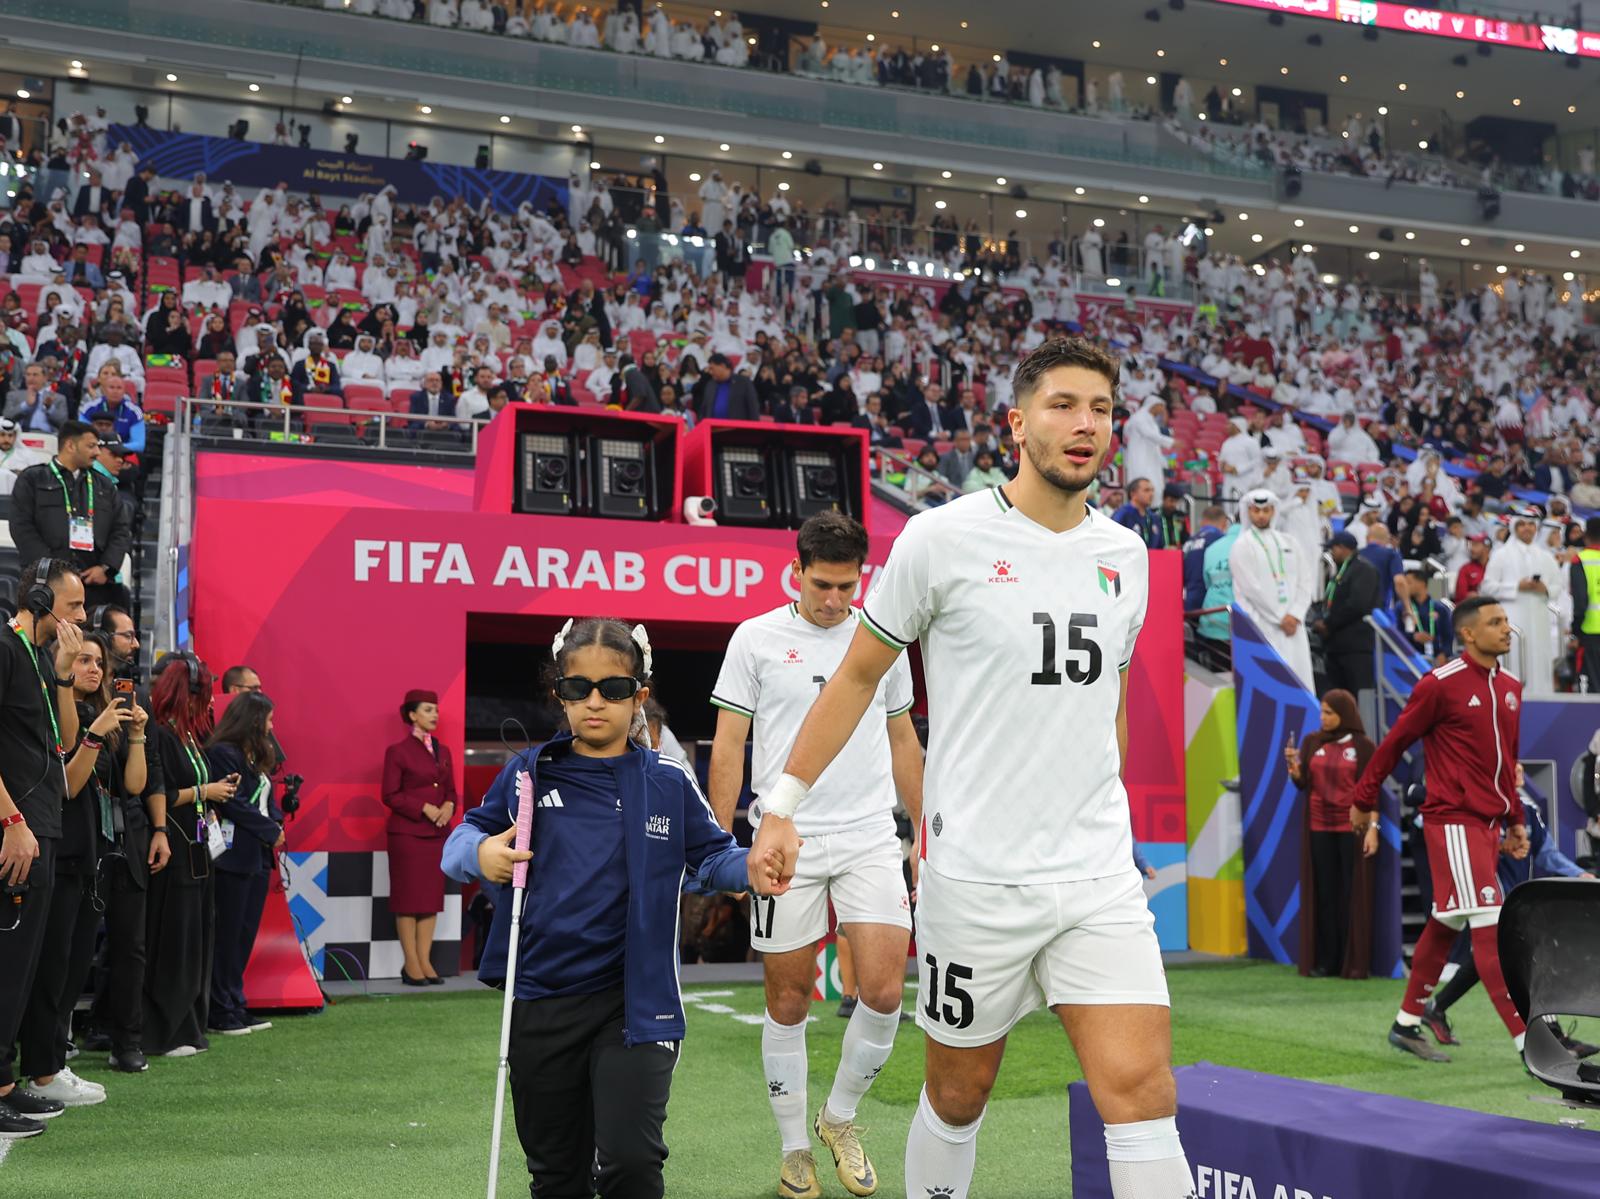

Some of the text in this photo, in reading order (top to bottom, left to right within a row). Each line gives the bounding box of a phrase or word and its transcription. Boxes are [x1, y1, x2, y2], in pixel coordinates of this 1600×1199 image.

[1404, 9, 1442, 30] QAT
[317, 170, 340, 182] Bayt
[343, 174, 385, 185] Stadium
[353, 539, 476, 585] FIFA
[492, 545, 646, 592] ARAB
[663, 554, 765, 598] CUP
[1031, 612, 1103, 686] 15
[649, 814, 671, 826] visit
[752, 894, 776, 938] 17
[925, 952, 975, 1029] 15
[1197, 1164, 1258, 1199] FIFA
